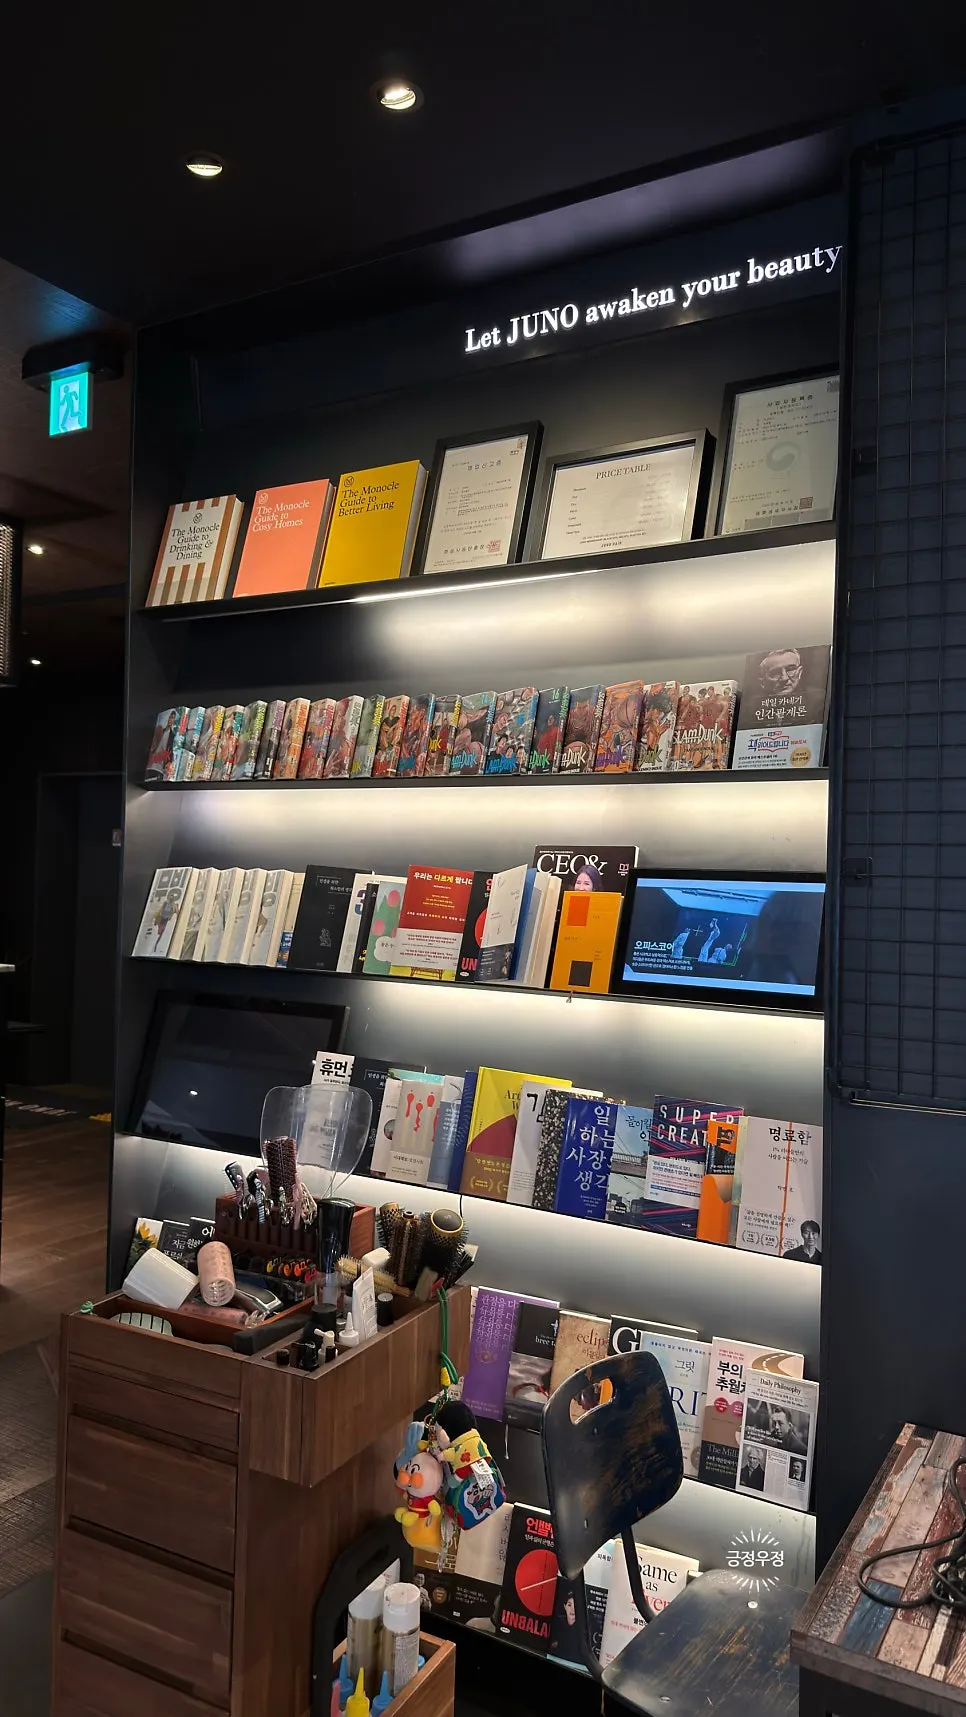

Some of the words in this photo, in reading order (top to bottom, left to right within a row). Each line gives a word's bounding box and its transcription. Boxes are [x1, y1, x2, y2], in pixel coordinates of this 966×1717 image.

[464, 327, 502, 353] Let
[506, 303, 579, 345] JUNO
[585, 286, 676, 324] awaken
[680, 268, 742, 308] your
[745, 244, 844, 286] beauty
[342, 489, 358, 499] The
[361, 481, 400, 496] Monocle
[256, 505, 273, 516] The
[274, 500, 310, 513] Monocle
[338, 506, 364, 517] Better
[366, 500, 395, 512] Living
[340, 496, 366, 508] Guide
[368, 494, 377, 503] to
[252, 522, 272, 533] Cosy
[274, 518, 303, 529] Homes
[254, 513, 279, 524] Guide
[280, 512, 289, 520] to
[171, 528, 186, 537] The
[187, 523, 220, 535] Monocle
[169, 543, 203, 553] Drinking
[204, 540, 214, 548] &
[177, 535, 200, 544] Guide
[176, 551, 203, 561] Dining
[778, 695, 803, 706] 카네기
[755, 705, 807, 721] 인간관계론
[413, 871, 433, 881] 우리는
[433, 874, 453, 883] 다르게
[633, 940, 674, 952] 오피스코어
[319, 1058, 353, 1079] 휴먼
[593, 1105, 612, 1127] 일
[579, 1125, 615, 1149] 하는
[657, 1123, 708, 1147] CREAT
[768, 1126, 812, 1146] 명료함
[576, 1328, 608, 1350] eclip
[674, 1359, 695, 1374] 그릿
[717, 1360, 744, 1379] 부의
[759, 1377, 773, 1388] Daily
[774, 1381, 802, 1396] Philosophy
[669, 1385, 707, 1416] RI
[645, 1581, 658, 1592] as
[501, 1608, 550, 1638] UNBALA
